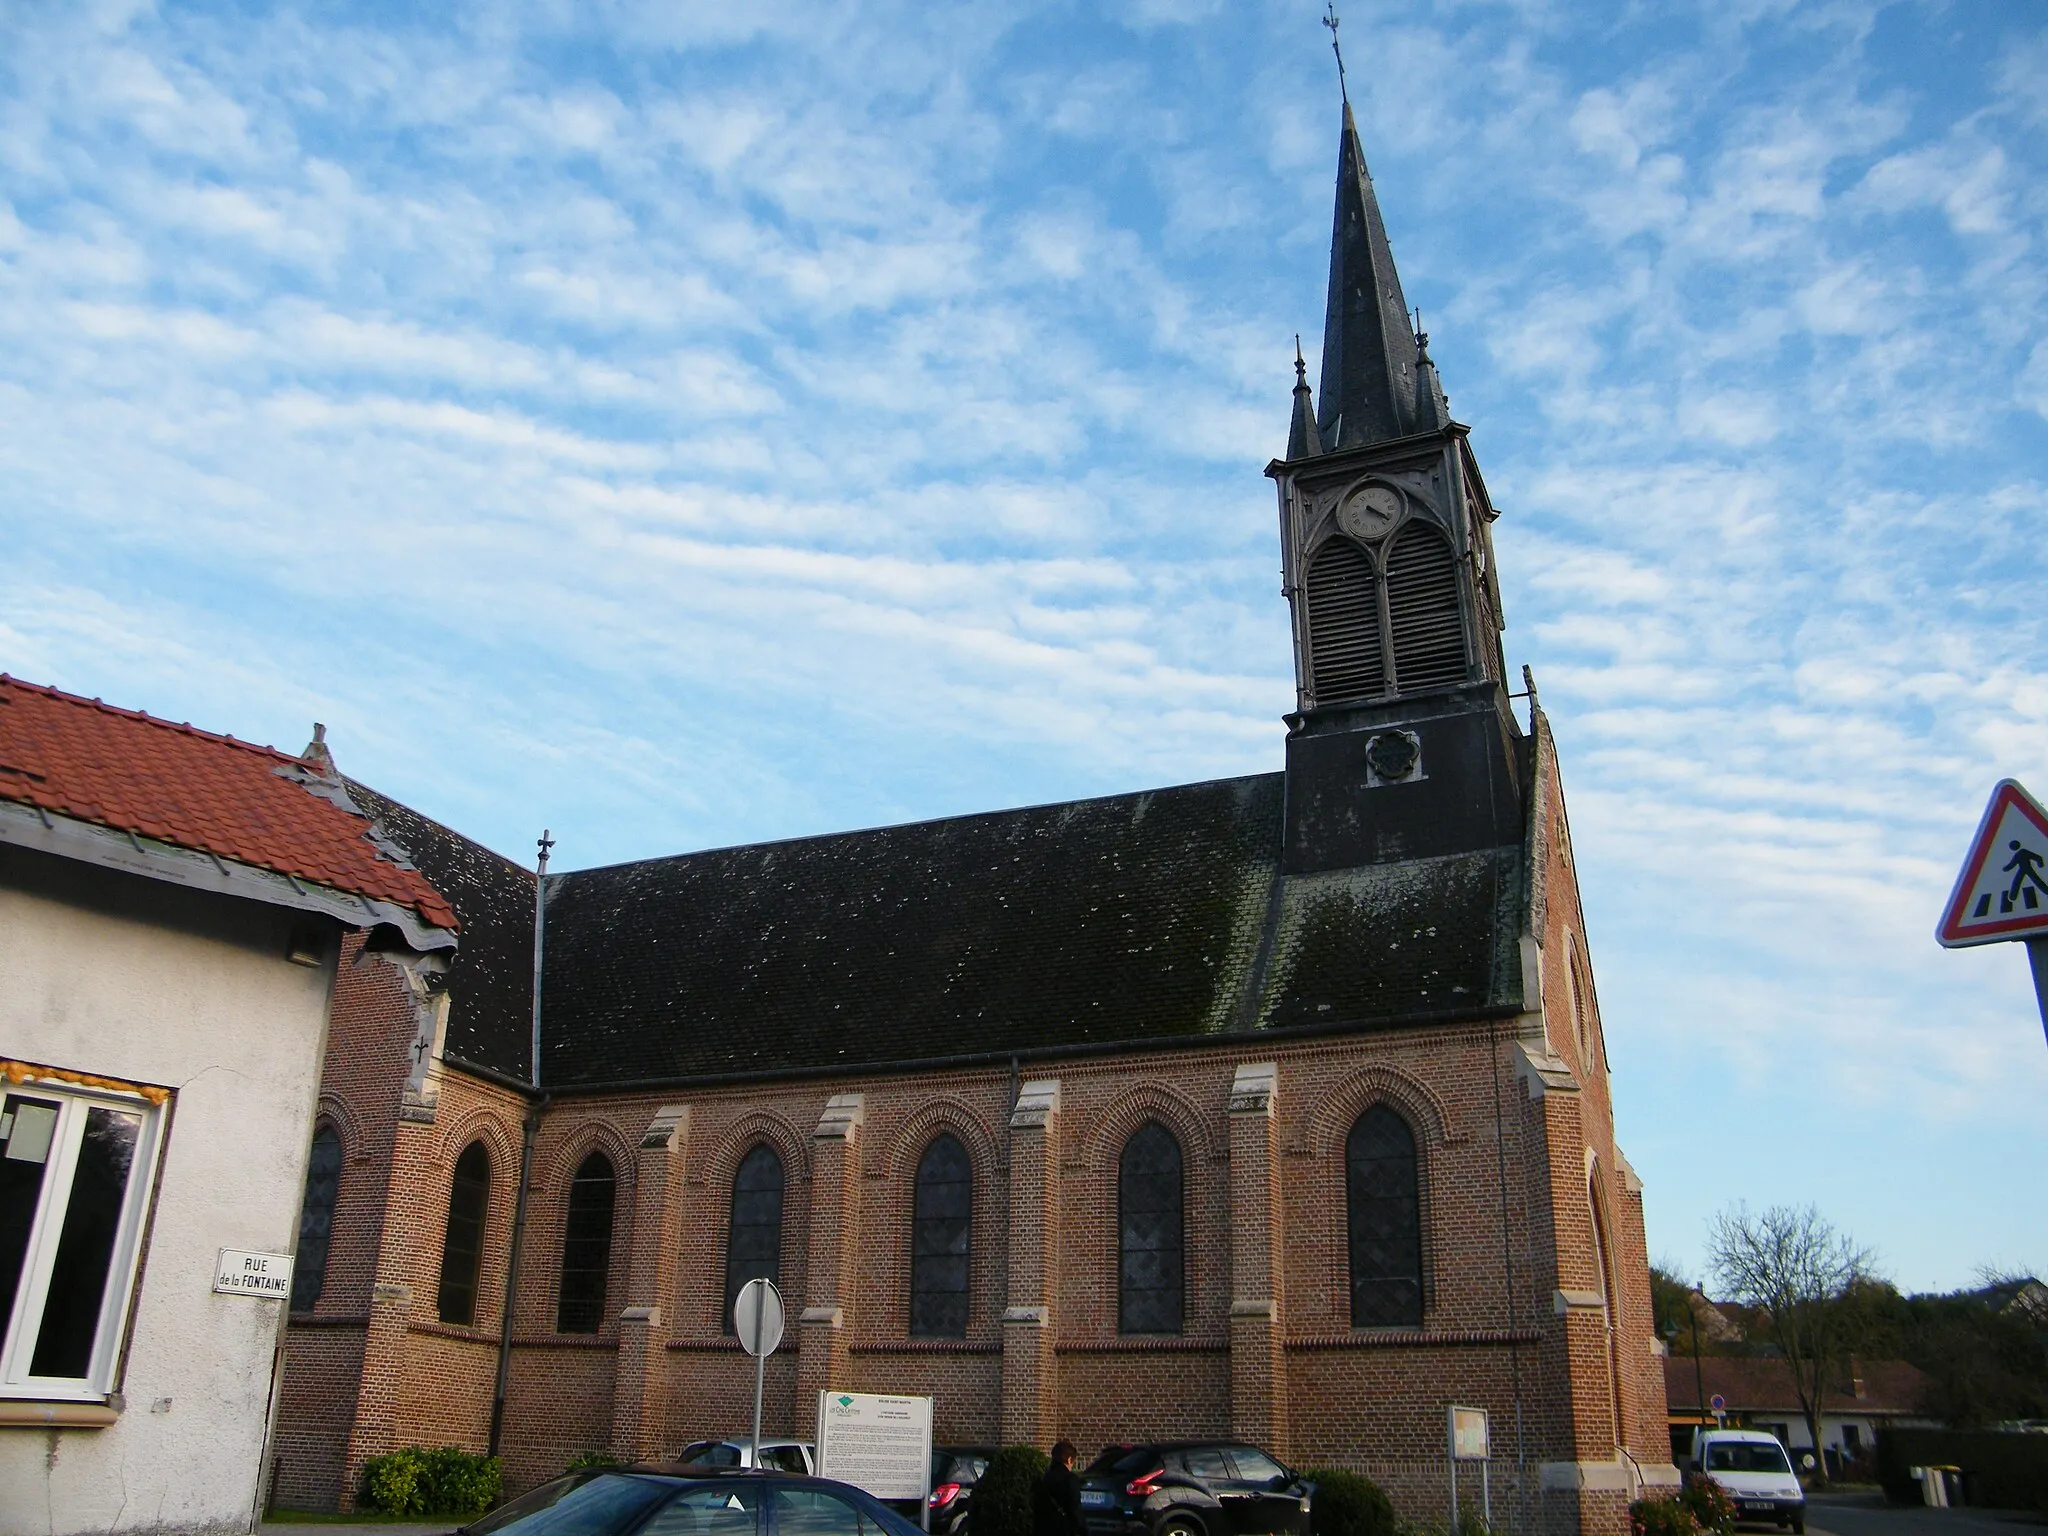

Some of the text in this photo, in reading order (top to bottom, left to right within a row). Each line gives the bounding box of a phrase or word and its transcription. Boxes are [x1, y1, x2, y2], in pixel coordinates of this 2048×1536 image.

[244, 1258, 268, 1272] RUE
[219, 1273, 287, 1291] de la FONTAINE
